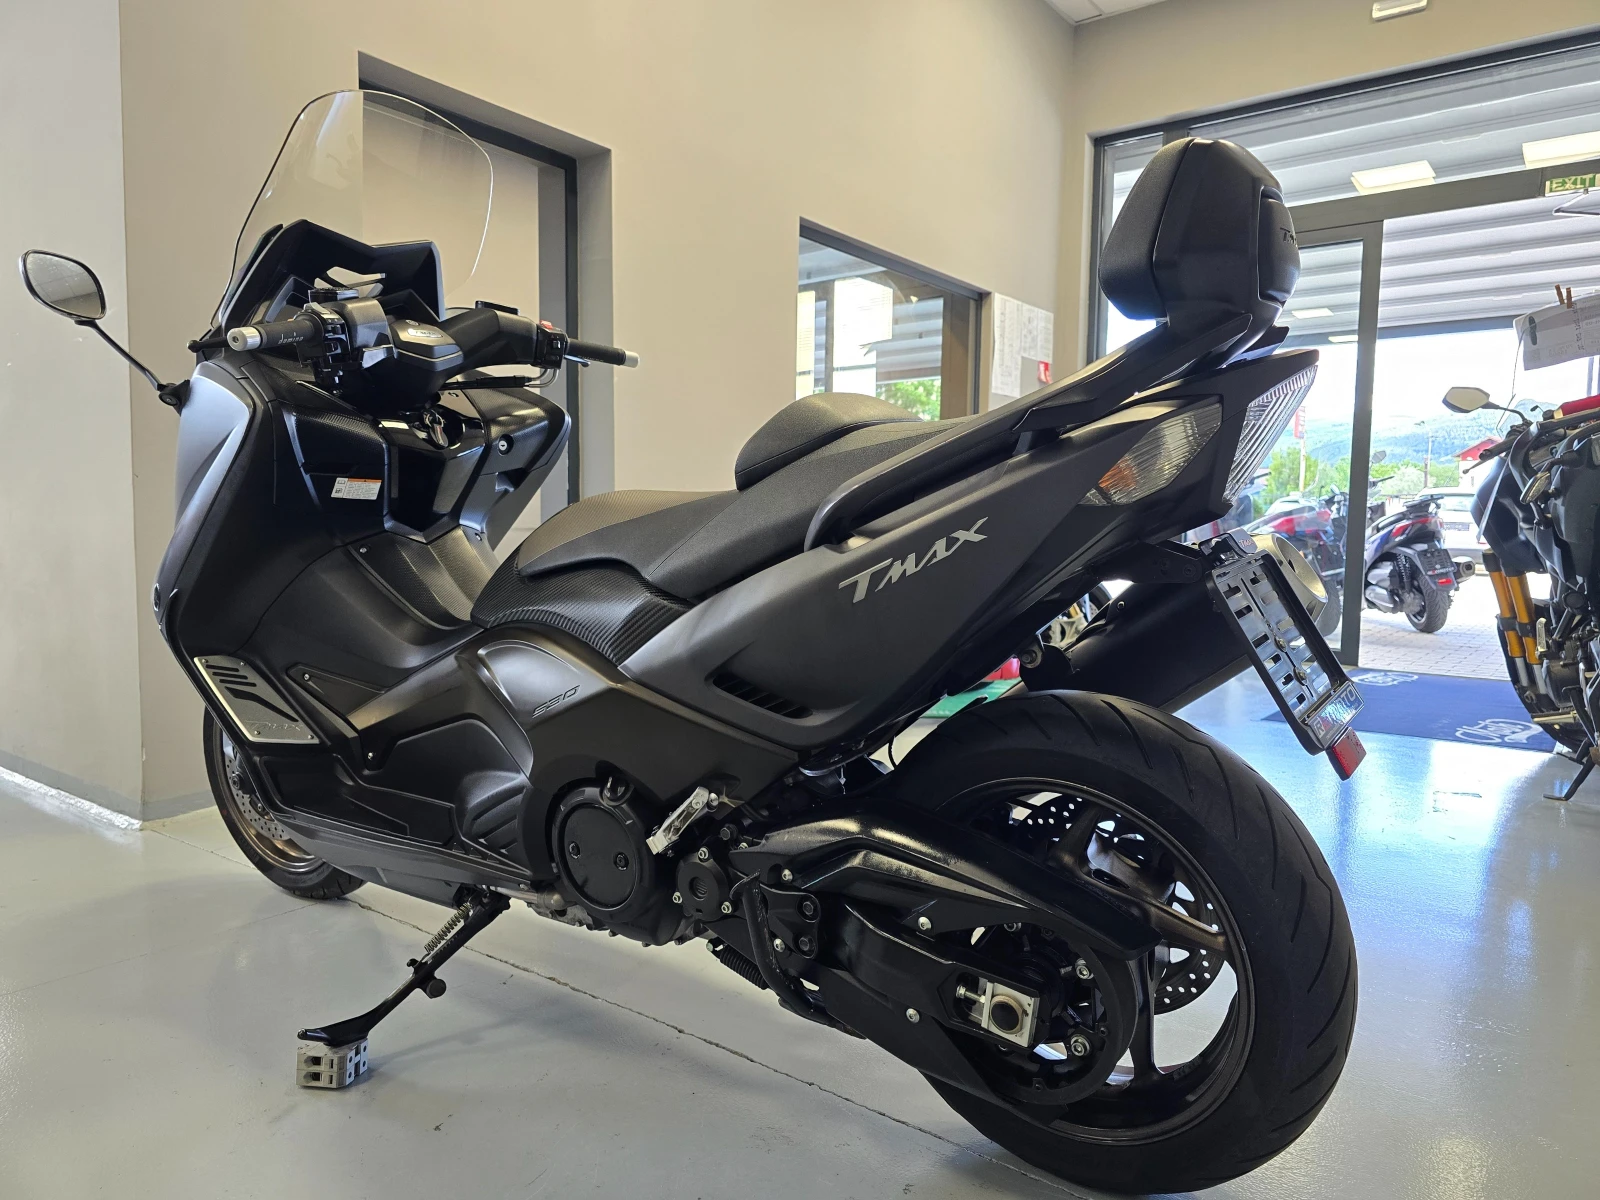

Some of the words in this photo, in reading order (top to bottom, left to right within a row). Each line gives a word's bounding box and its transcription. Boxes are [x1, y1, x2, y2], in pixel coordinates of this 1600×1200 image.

[1551, 174, 1594, 192] EXIT
[838, 516, 989, 603] TMAX
[532, 684, 581, 719] 530
